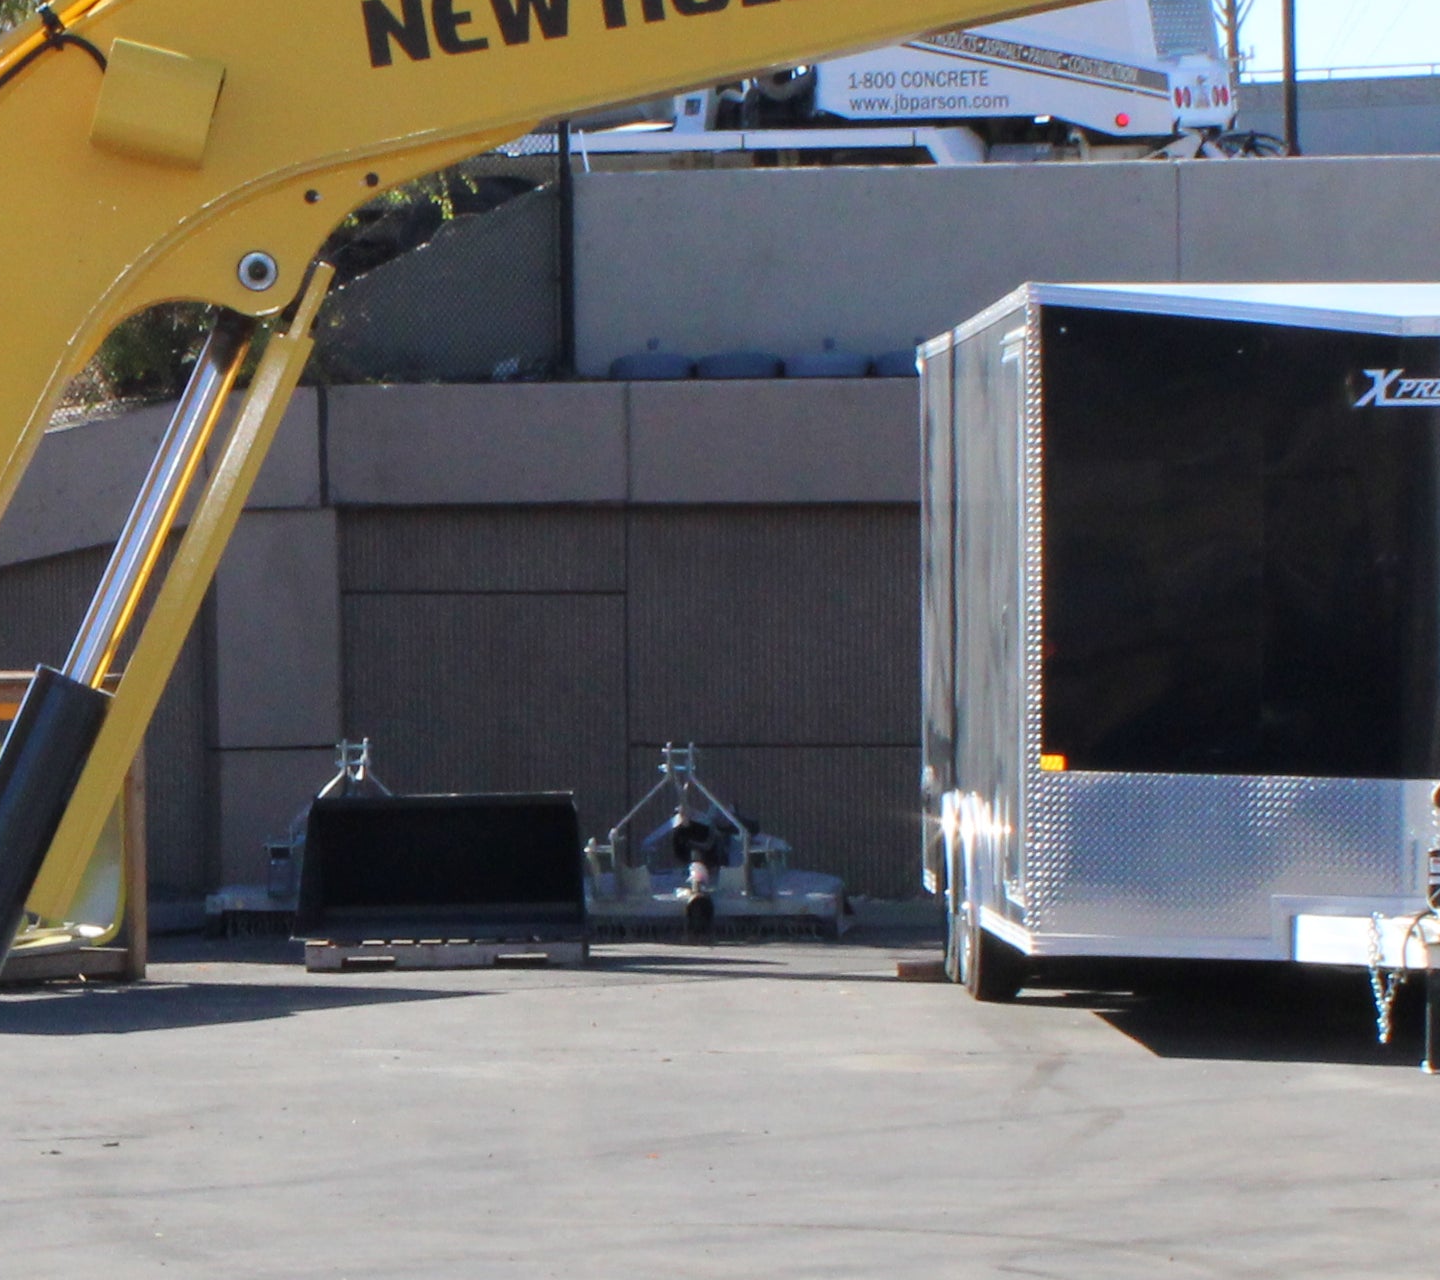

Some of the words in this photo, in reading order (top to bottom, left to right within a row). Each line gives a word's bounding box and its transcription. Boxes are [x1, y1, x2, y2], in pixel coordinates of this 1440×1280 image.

[848, 72, 895, 89] 1-800
[900, 70, 988, 88] CONCRETE
[849, 94, 1009, 113] www.jbparson.com
